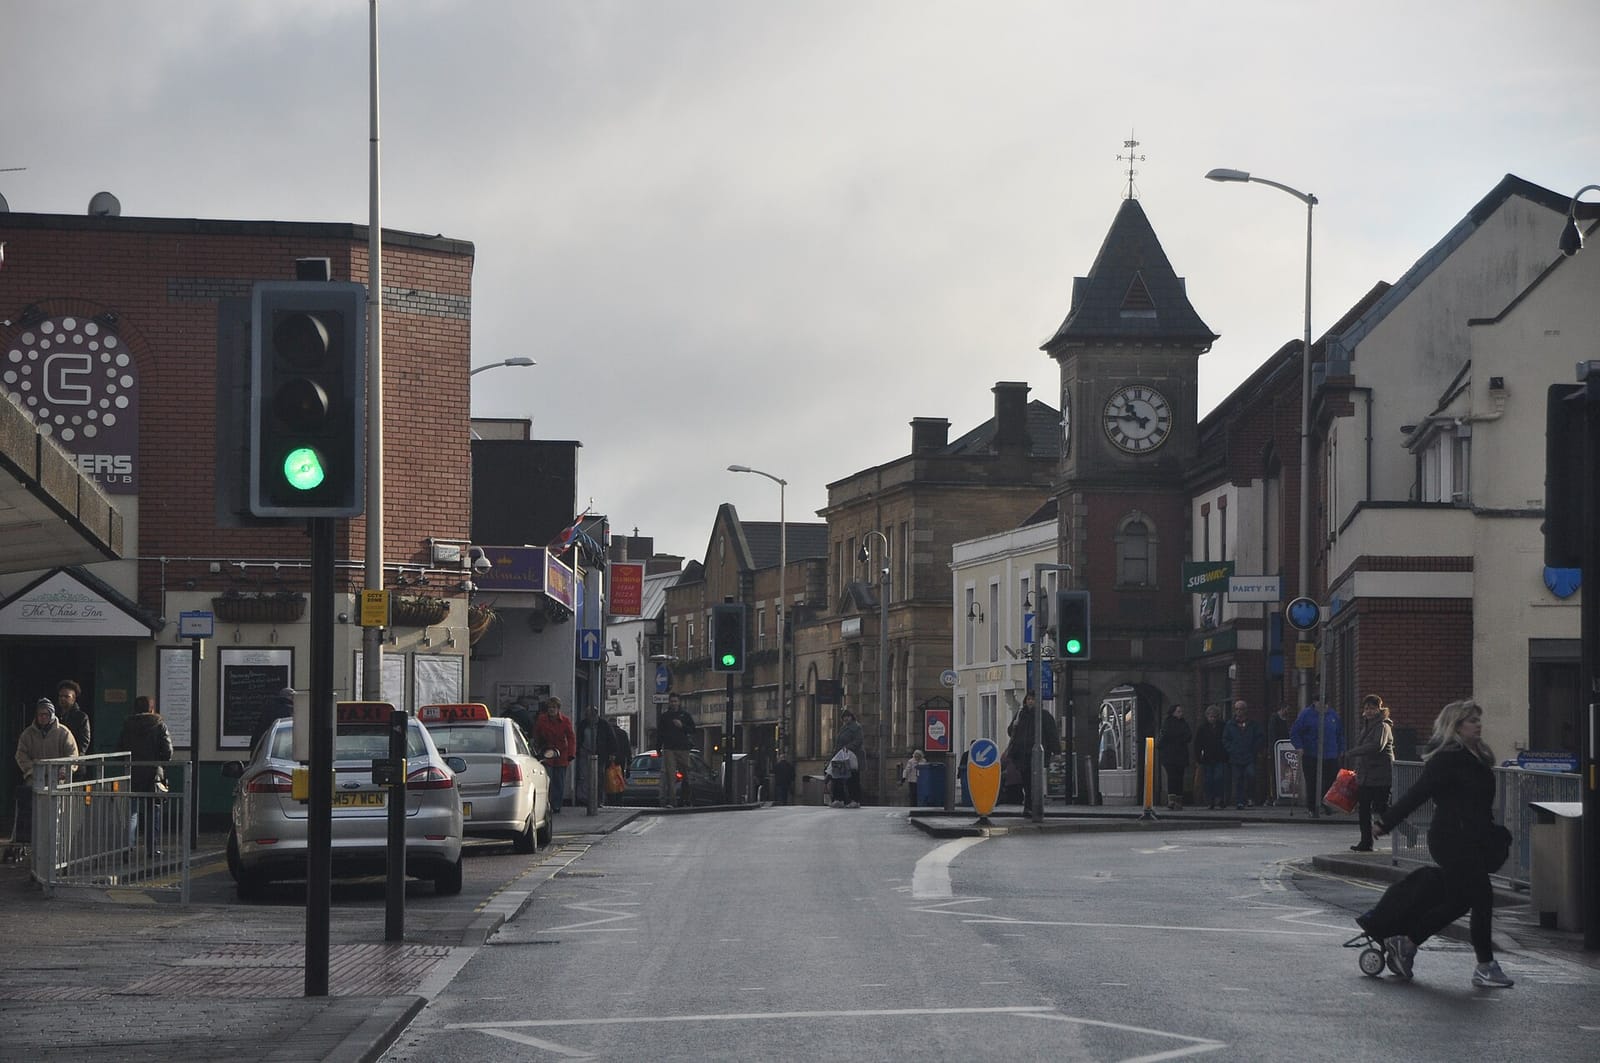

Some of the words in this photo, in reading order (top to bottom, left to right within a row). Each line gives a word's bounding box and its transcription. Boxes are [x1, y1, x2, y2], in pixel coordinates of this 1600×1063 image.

[72, 454, 132, 474] ERS
[92, 475, 132, 483] LUB
[1187, 568, 1228, 588] SUBWAY
[22, 603, 48, 617] The
[49, 603, 78, 617] Chase
[82, 605, 103, 617] Inn
[338, 708, 382, 719] TAXI
[441, 708, 475, 718] TAXI
[333, 793, 356, 804] M57
